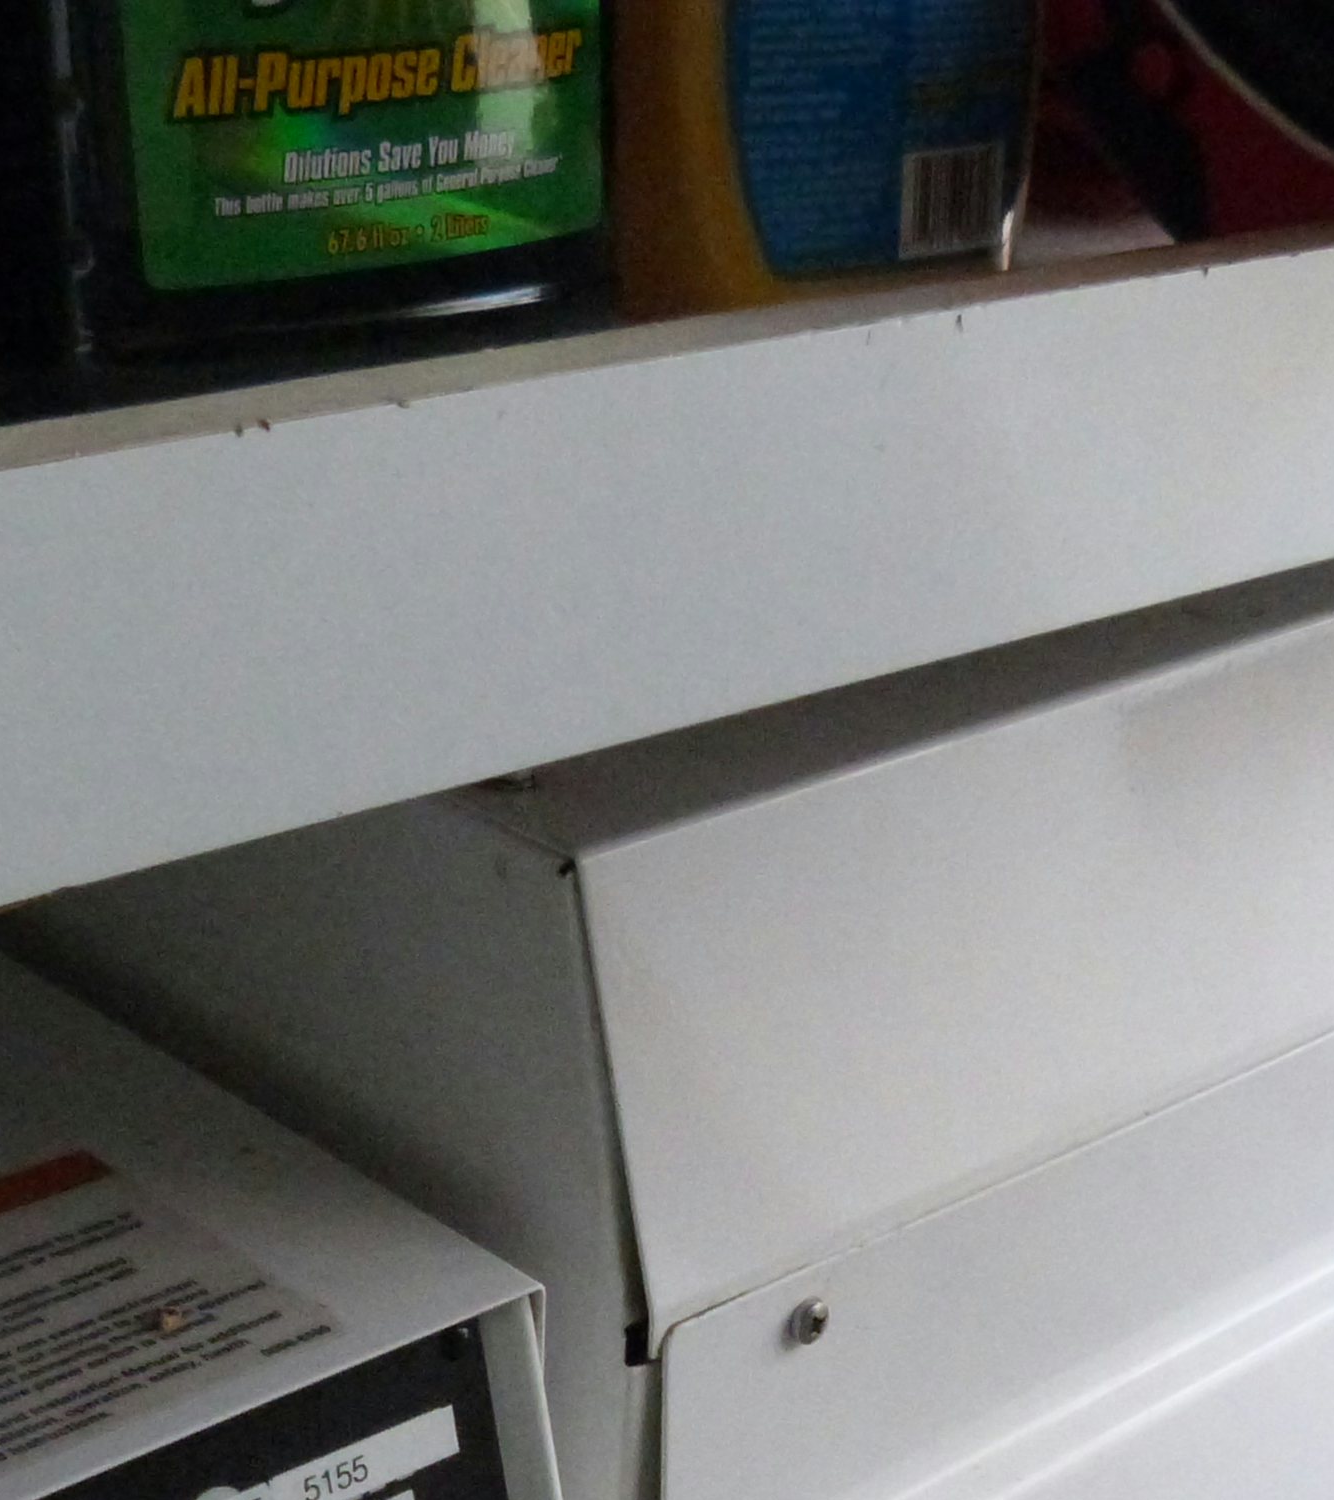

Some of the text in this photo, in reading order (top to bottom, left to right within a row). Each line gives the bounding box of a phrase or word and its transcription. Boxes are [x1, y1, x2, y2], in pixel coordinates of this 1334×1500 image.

[173, 28, 582, 121] All-Purpose Cleaner
[281, 141, 372, 184] Dilutions
[377, 135, 423, 173] Save
[429, 131, 459, 167] You
